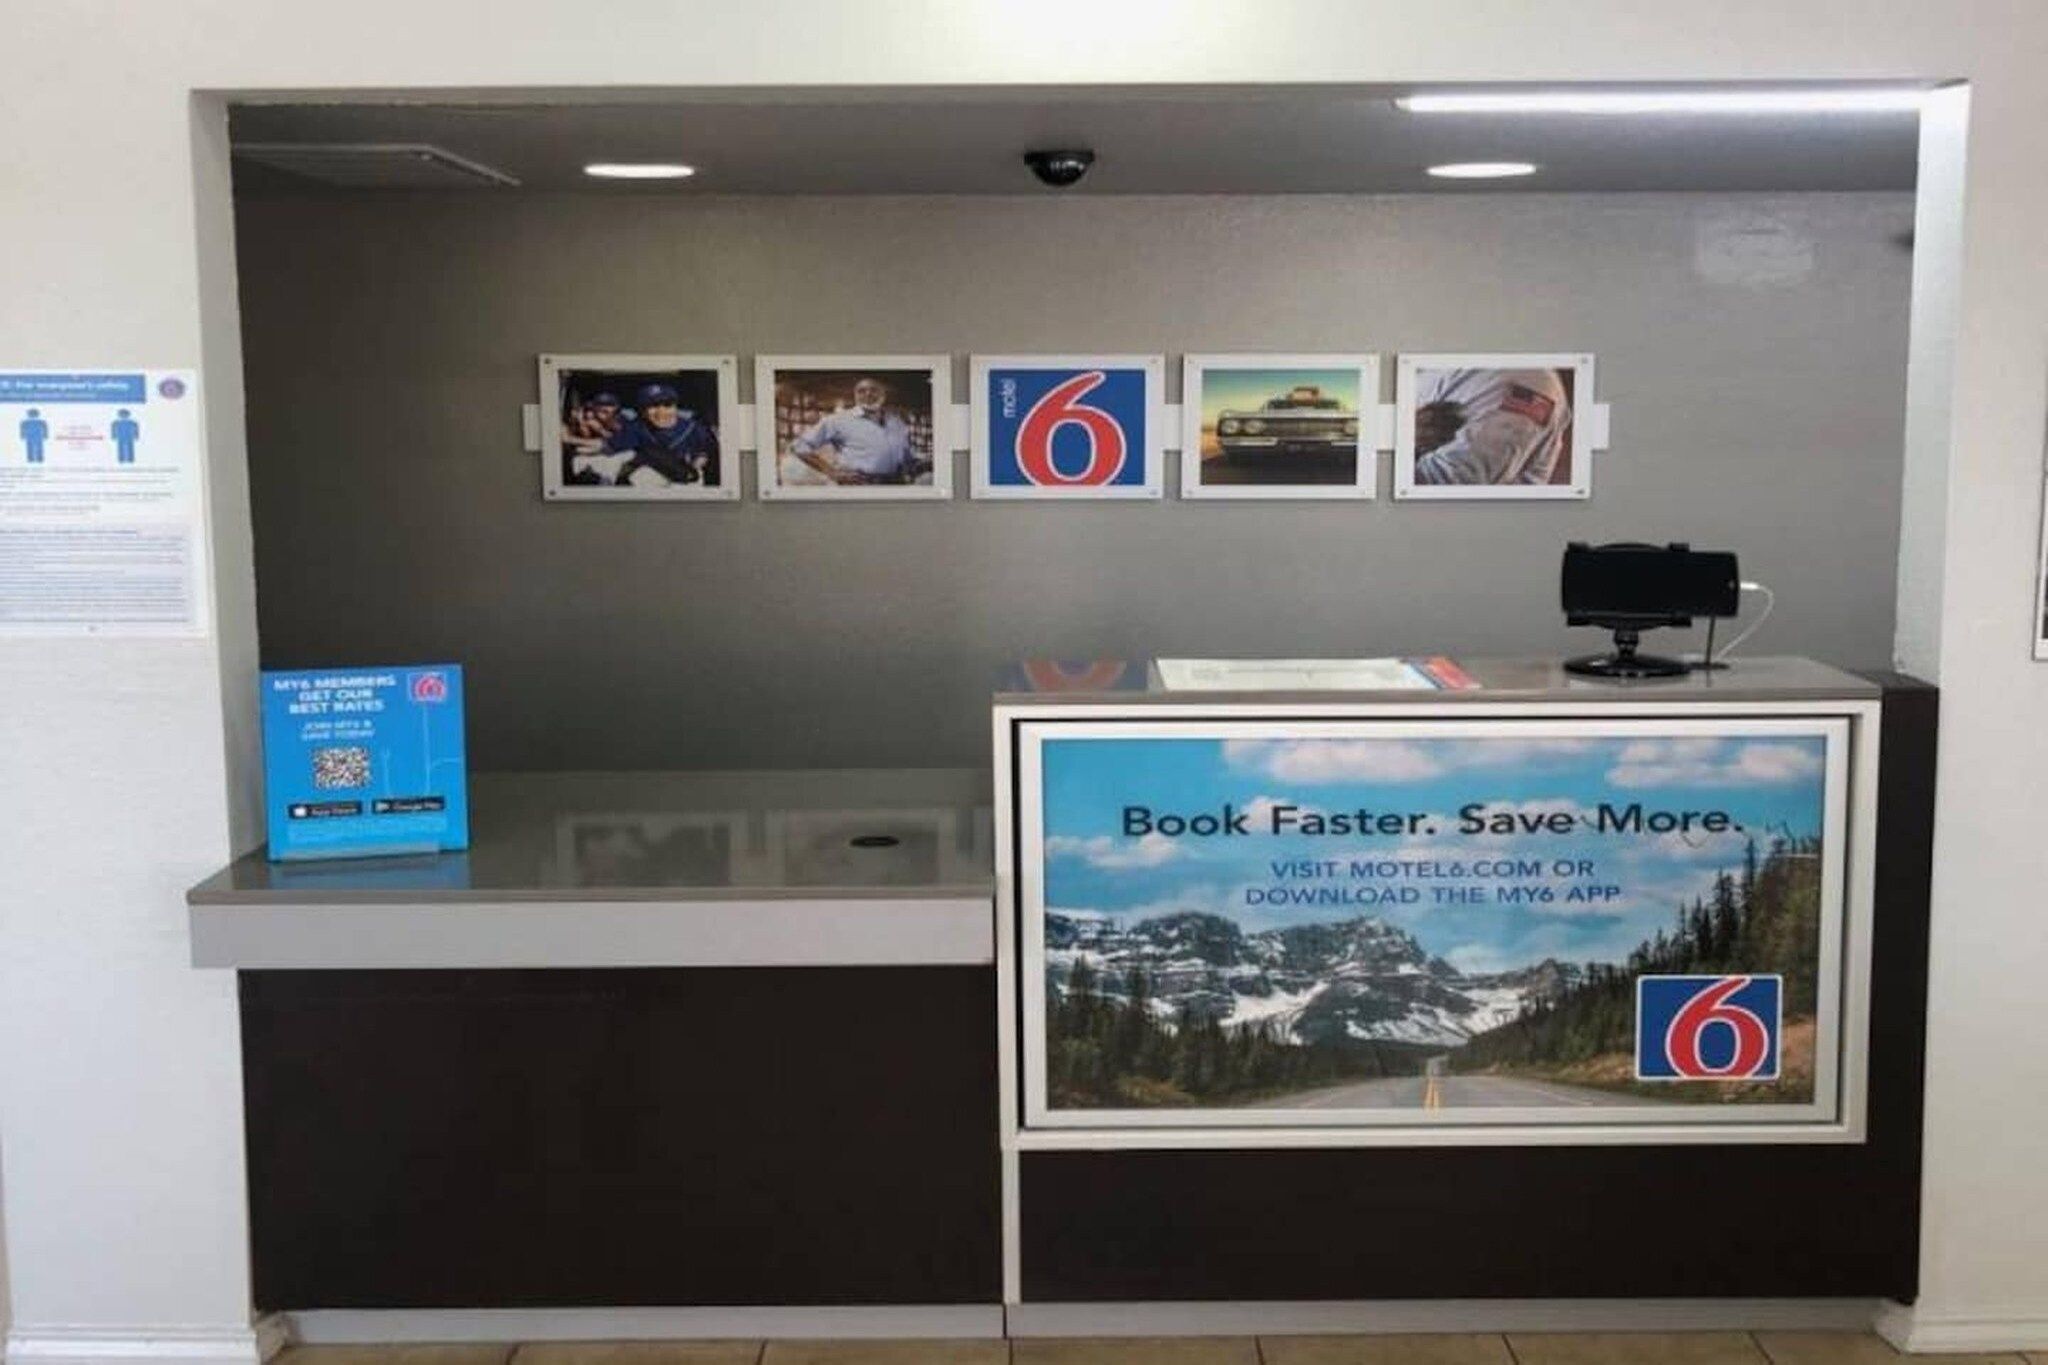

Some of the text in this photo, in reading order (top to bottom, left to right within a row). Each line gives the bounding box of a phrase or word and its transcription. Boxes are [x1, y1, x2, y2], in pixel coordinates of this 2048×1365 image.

[998, 378, 1019, 418] motel
[1014, 370, 1128, 486] 6
[273, 674, 397, 691] MY6 MEMBERS
[299, 688, 373, 702] GET OUR
[288, 700, 385, 714] BEST RATES
[1122, 802, 1743, 837] Book Faster. Save More.
[1270, 860, 1595, 879] VISIT MOTEL6.COM OR
[1245, 886, 1620, 905] DOWNLOAD THE MY6 APP
[1664, 974, 1770, 1080] 6
